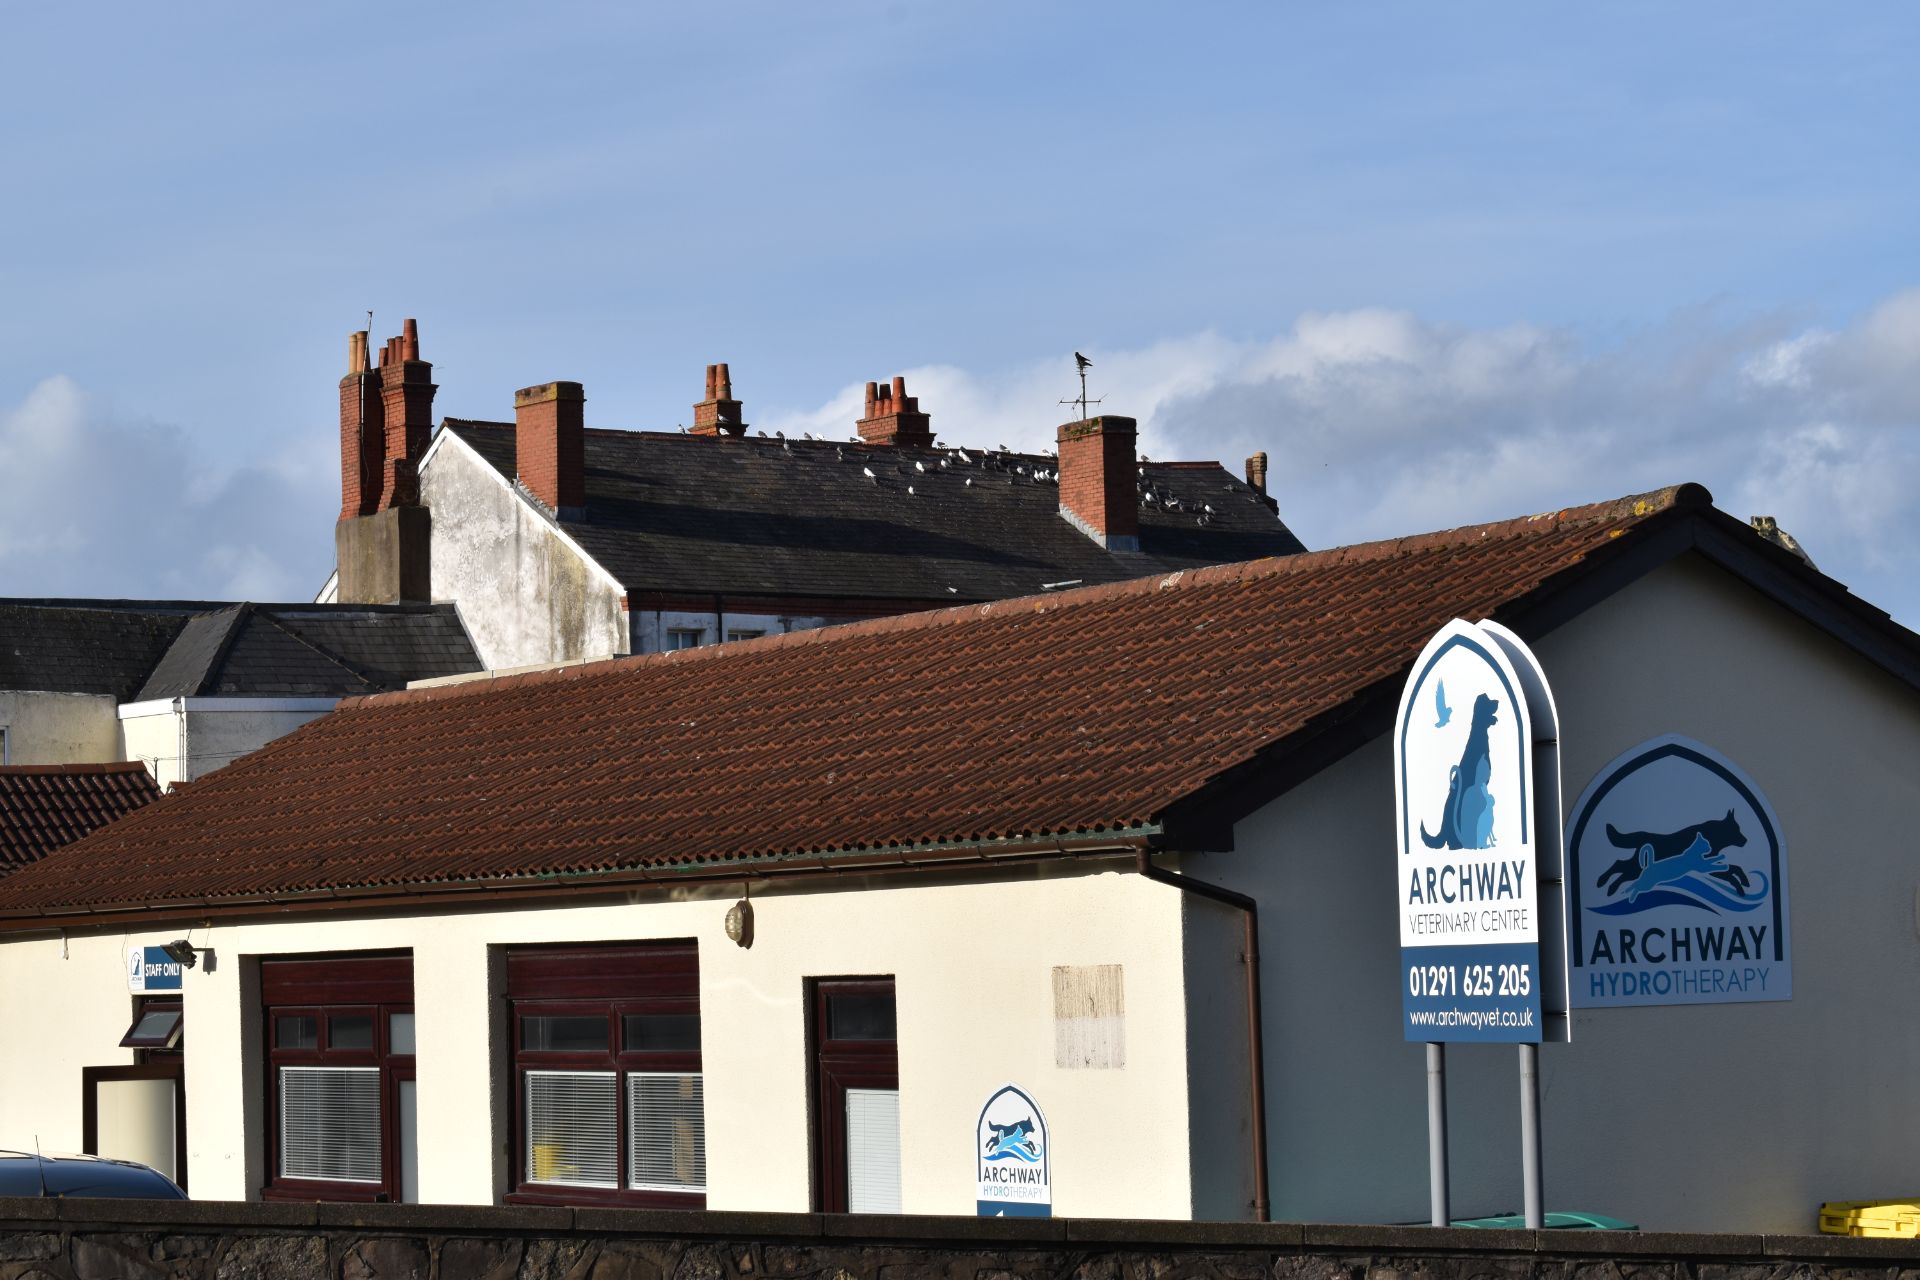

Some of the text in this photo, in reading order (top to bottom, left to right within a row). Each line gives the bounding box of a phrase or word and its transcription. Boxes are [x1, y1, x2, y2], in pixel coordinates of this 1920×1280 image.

[1408, 860, 1526, 905] ARCHWAY
[1408, 909, 1529, 934] VETERINARY CENTRE
[1589, 925, 1768, 965] ARCHWAY
[145, 962, 180, 977] STAFF ONLY
[1409, 964, 1531, 997] 01291 625 205
[1589, 967, 1770, 997] HYDROTHERAPY
[1409, 1007, 1534, 1031] www.archwayvet.co.uk
[983, 1166, 1042, 1184] ARCHWAY
[983, 1185, 1043, 1199] HYDROTHERAPY
